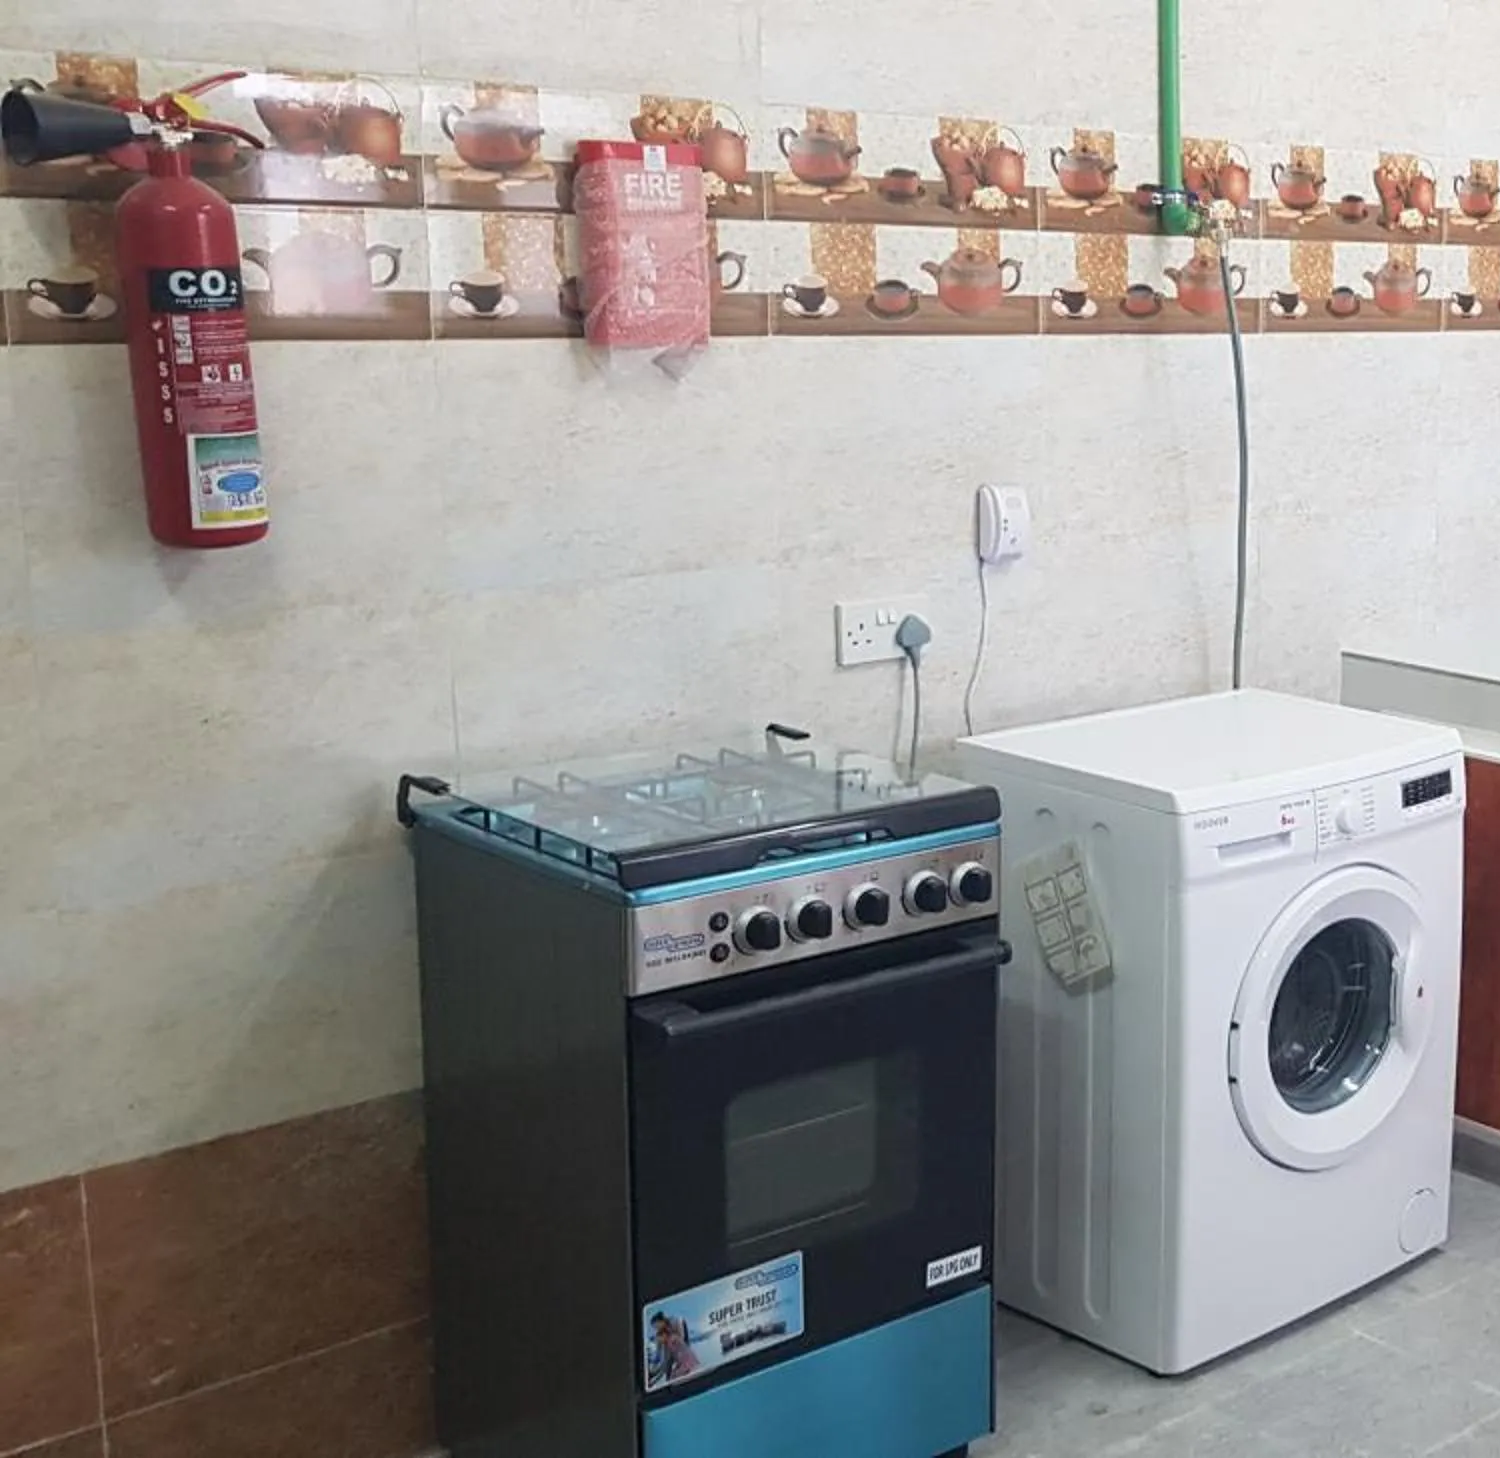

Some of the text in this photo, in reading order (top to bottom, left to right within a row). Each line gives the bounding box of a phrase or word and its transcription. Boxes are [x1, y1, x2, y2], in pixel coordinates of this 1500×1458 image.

[624, 173, 682, 198] FIRE
[708, 1301, 743, 1326] SUPER
[745, 1288, 777, 1311] TRUST
